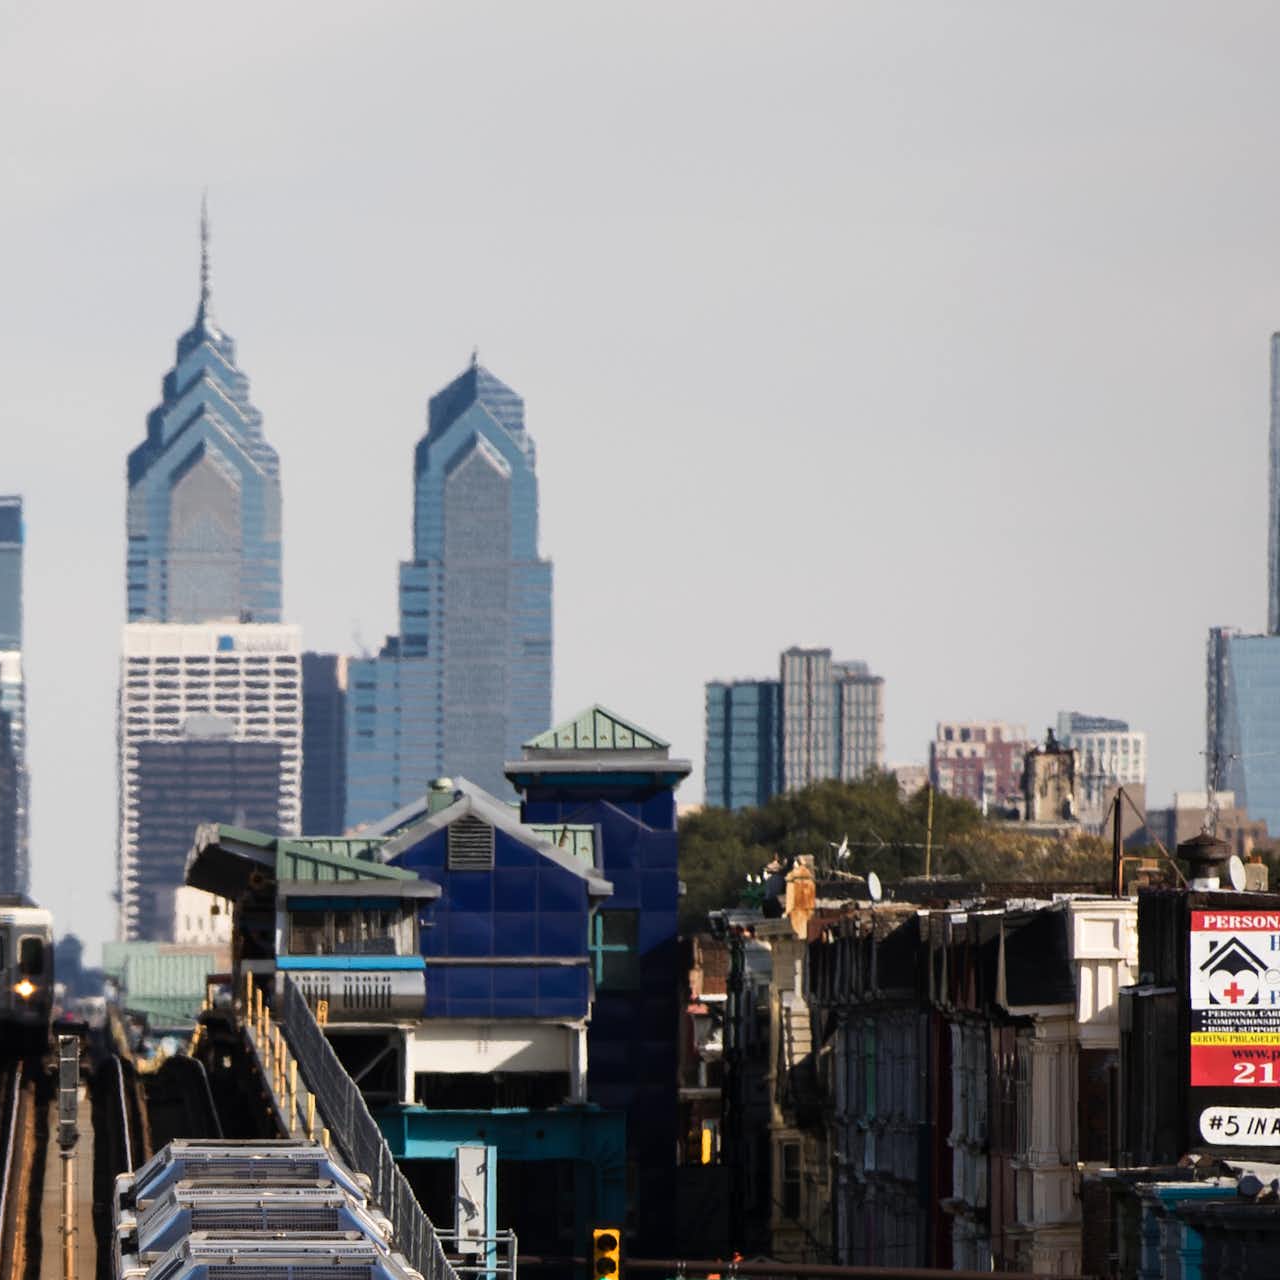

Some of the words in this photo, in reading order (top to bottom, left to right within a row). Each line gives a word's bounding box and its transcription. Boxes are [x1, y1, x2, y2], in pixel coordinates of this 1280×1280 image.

[1203, 915, 1280, 929] PERSON
[1232, 1050, 1280, 1061] www.p
[1233, 1062, 1280, 1084] 21
[1247, 1116, 1268, 1135] IN
